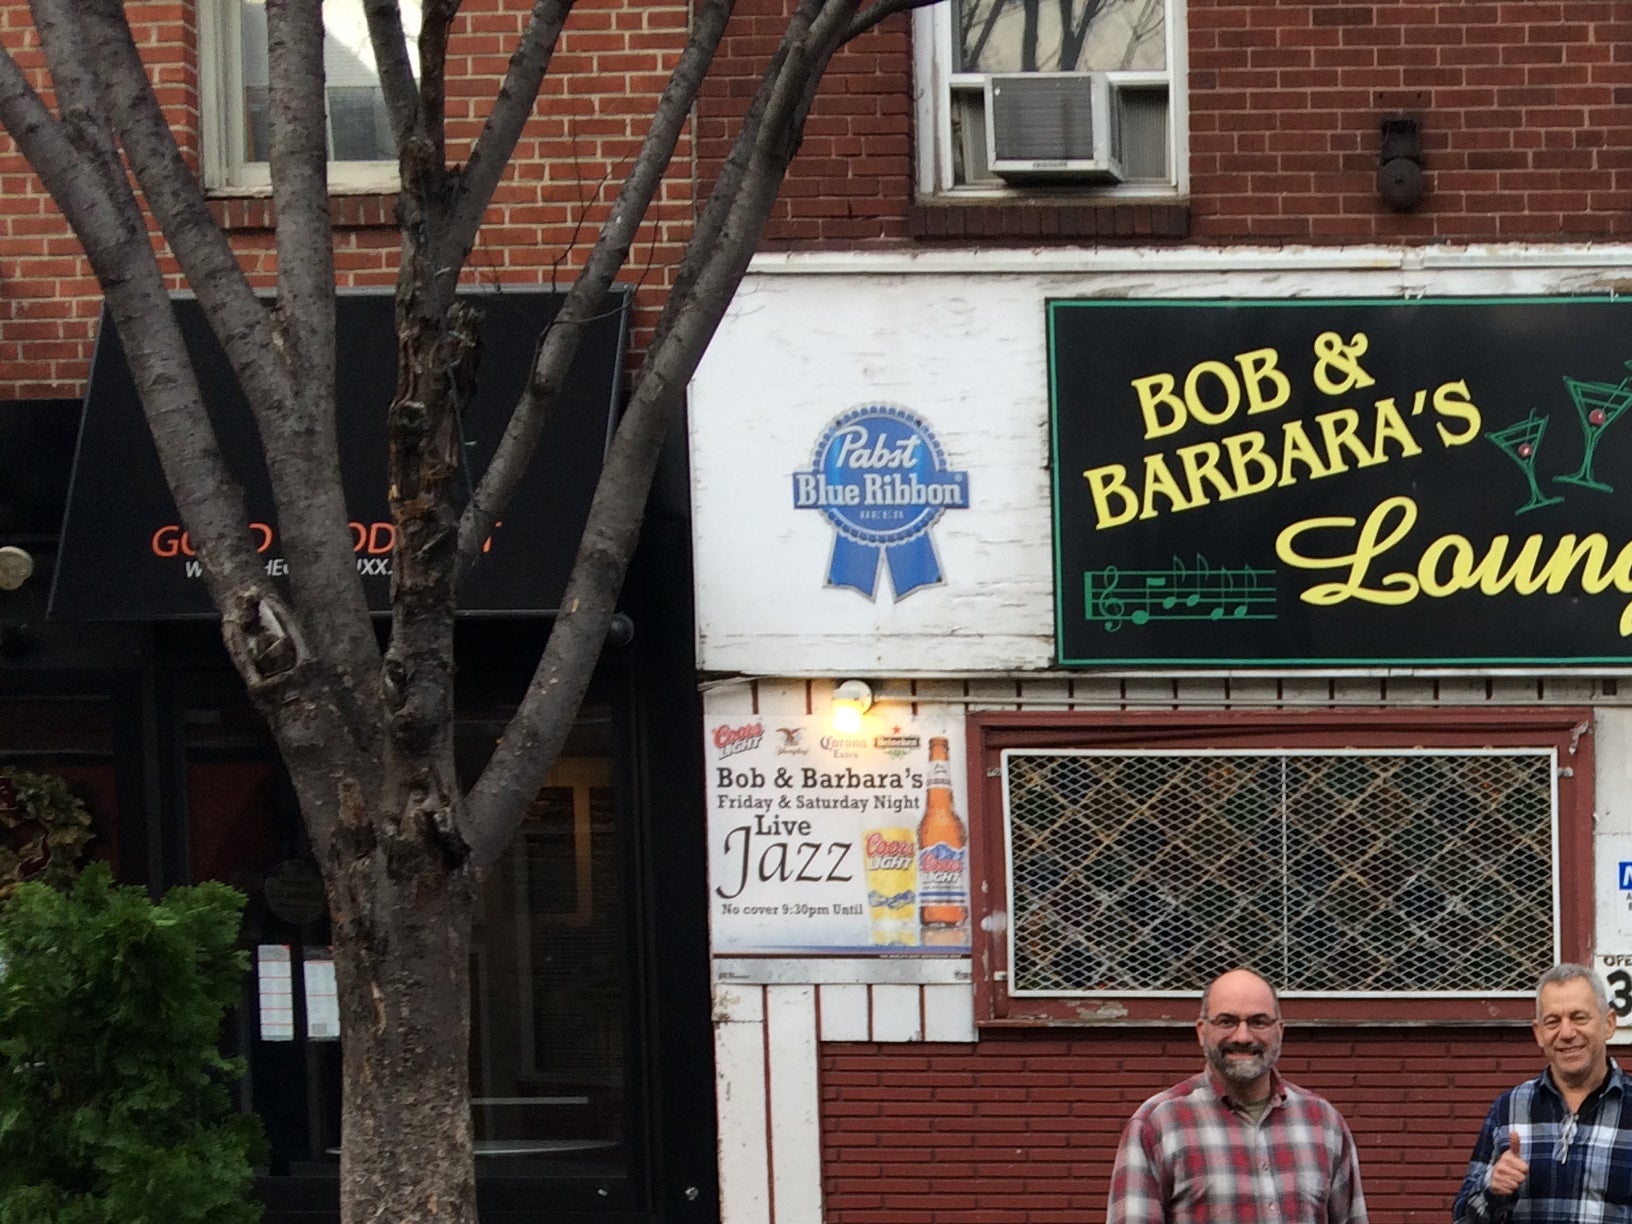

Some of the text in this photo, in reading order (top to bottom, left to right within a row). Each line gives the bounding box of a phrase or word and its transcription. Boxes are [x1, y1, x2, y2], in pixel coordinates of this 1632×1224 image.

[1131, 331, 1375, 440] BOB &
[836, 424, 922, 470] Pabst
[1083, 378, 1482, 530] BARBARA'S
[796, 472, 963, 507] Blue Ribbon
[713, 722, 765, 749] Coors
[718, 735, 763, 761] LIGHT
[819, 735, 868, 751] Corona
[716, 766, 766, 789] Bob
[773, 766, 794, 789] &
[800, 766, 924, 789] Barbara's
[717, 794, 920, 815] Friday & Saturday Night
[755, 814, 812, 838] Live
[865, 831, 915, 858] Coors
[715, 824, 854, 900] Jazz
[868, 855, 913, 872] LIGHT
[721, 902, 864, 919] No cover 9:30pm Until
